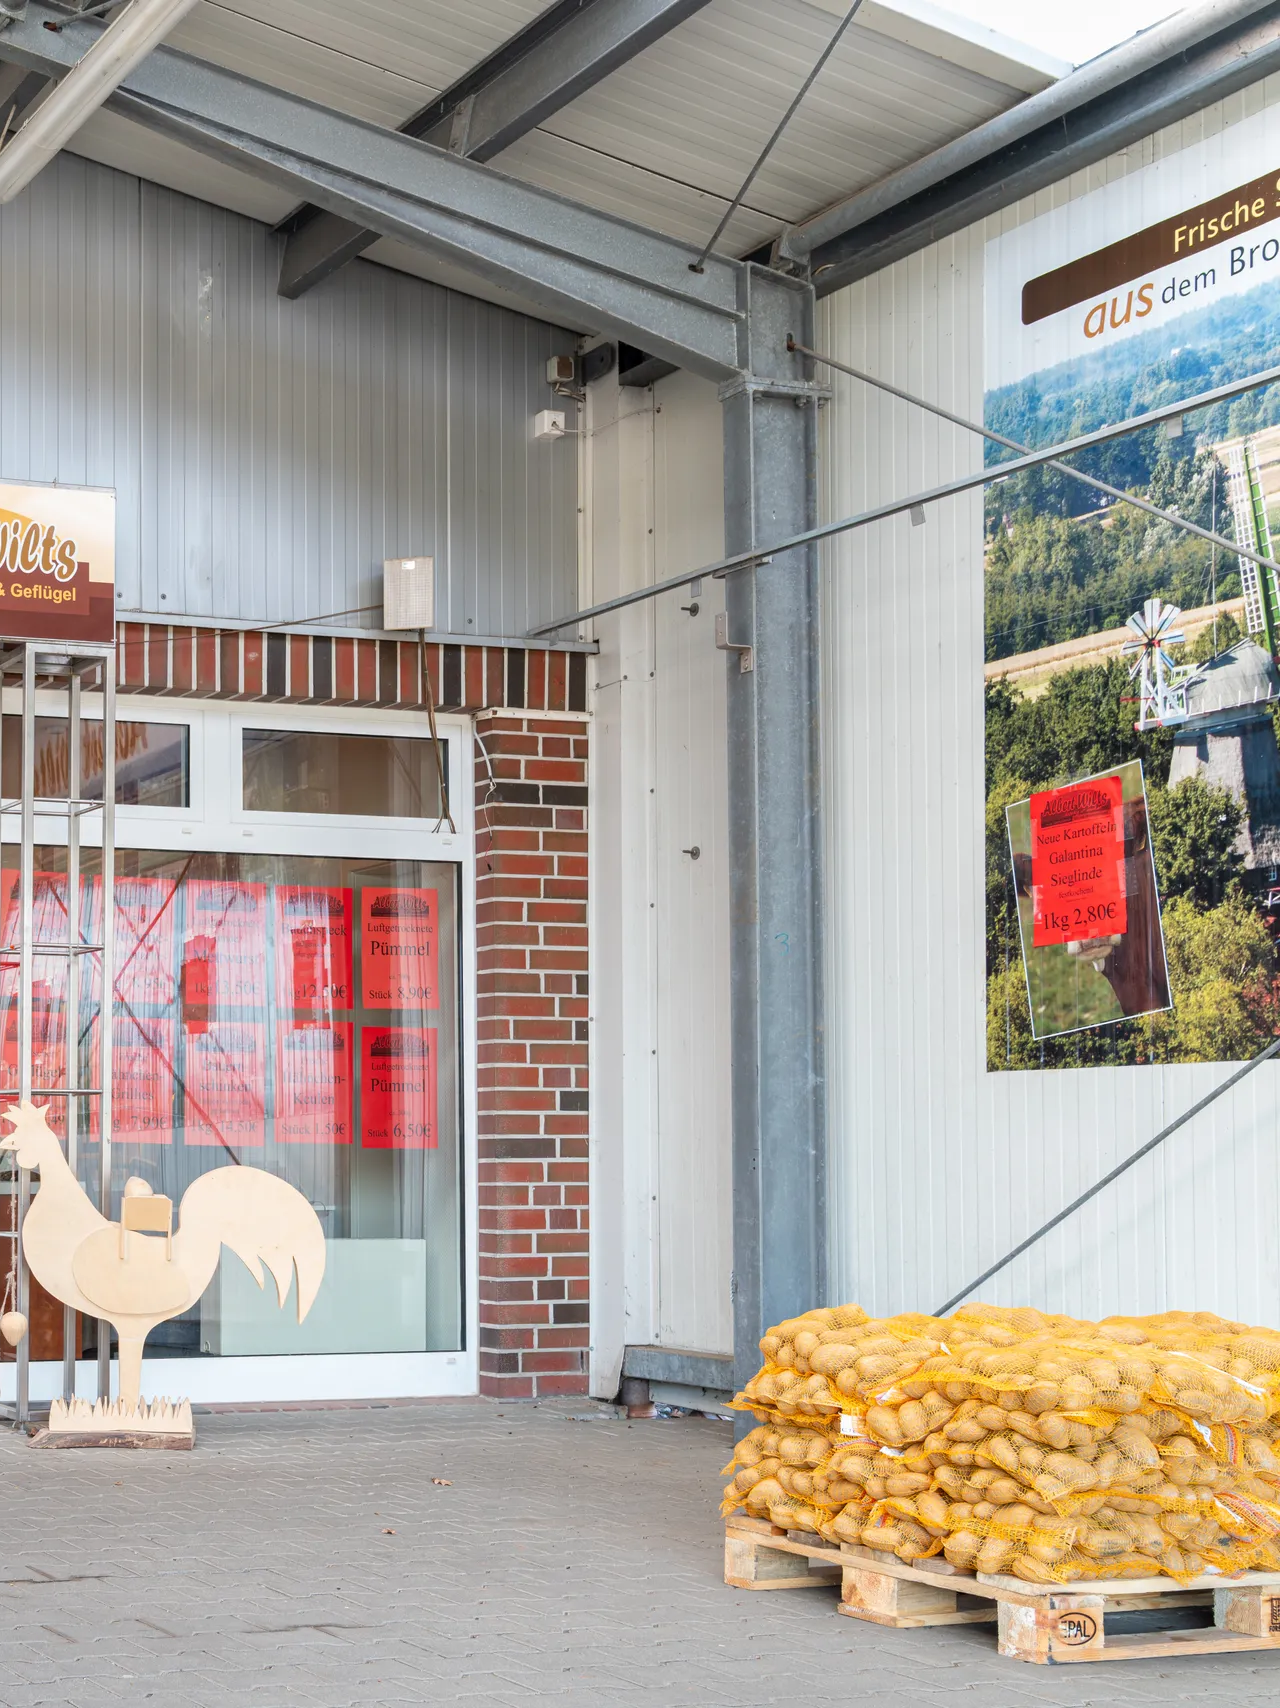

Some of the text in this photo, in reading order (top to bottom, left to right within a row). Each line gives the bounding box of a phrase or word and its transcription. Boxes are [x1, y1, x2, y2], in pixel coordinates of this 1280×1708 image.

[1174, 196, 1265, 253] Frische
[1083, 282, 1154, 338] aus
[1161, 268, 1216, 304] dem
[10, 580, 77, 602] Geflügel
[1042, 789, 1108, 817] Albert Wilts
[1036, 822, 1118, 846] Neue Kartoffeln
[1049, 846, 1104, 866] Galantina
[1050, 866, 1103, 887] Sieglinde
[373, 896, 427, 911] Albert Wilts
[1043, 902, 1118, 933] 1kg 2,80€
[367, 922, 433, 934] Luftgetrocknete
[370, 941, 430, 956] Pümmel
[369, 985, 432, 1000] Stück 8,90€
[372, 1062, 429, 1072] Luftgetrocknete
[370, 1078, 426, 1093] Pümmel
[294, 1093, 335, 1105] Keulen
[282, 1123, 347, 1136] Stück 1,50€
[367, 1122, 432, 1141] Stück 6,50€
